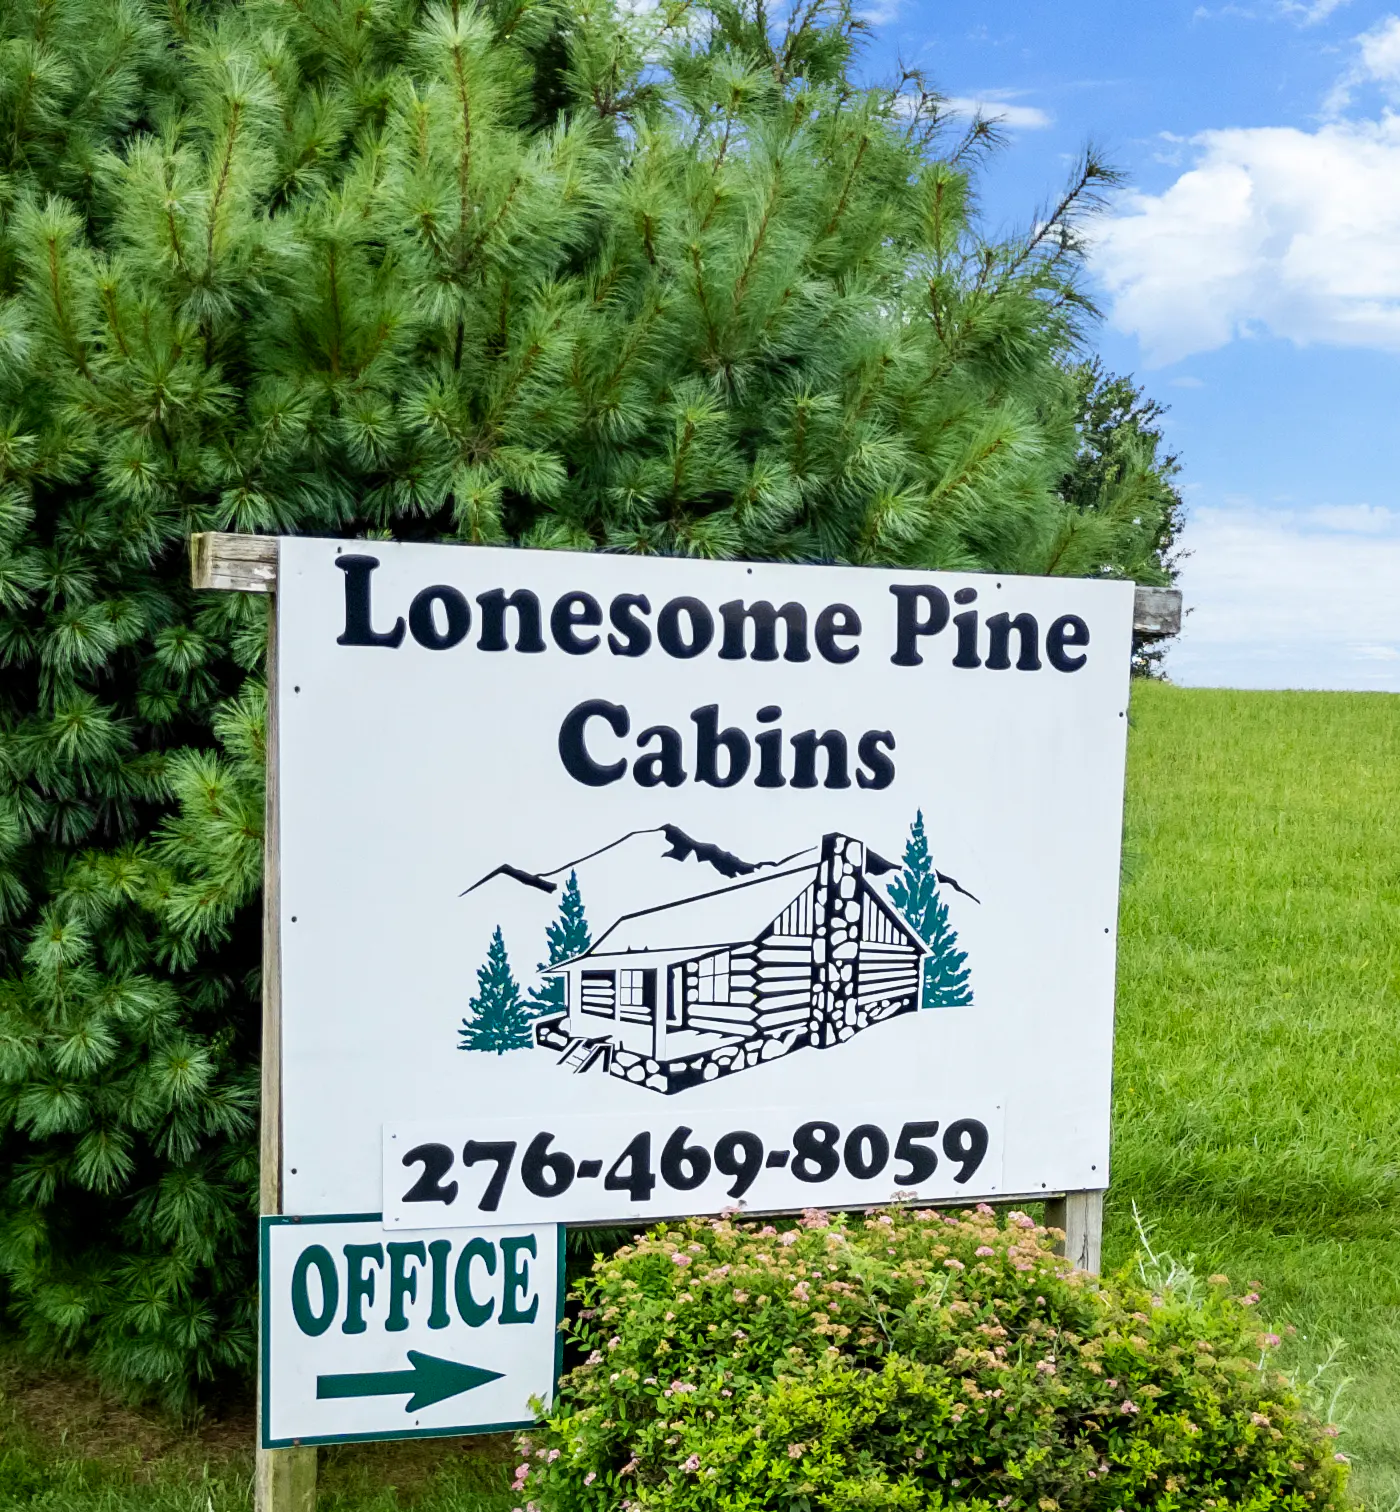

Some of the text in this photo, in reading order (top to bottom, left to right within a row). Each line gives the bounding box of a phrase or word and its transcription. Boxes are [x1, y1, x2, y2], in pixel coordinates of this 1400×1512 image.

[334, 554, 1090, 673] Lonesome Pine
[558, 698, 897, 791] Cabins
[401, 1118, 989, 1212] 276-469-8059
[291, 1233, 539, 1337] OFFICE
